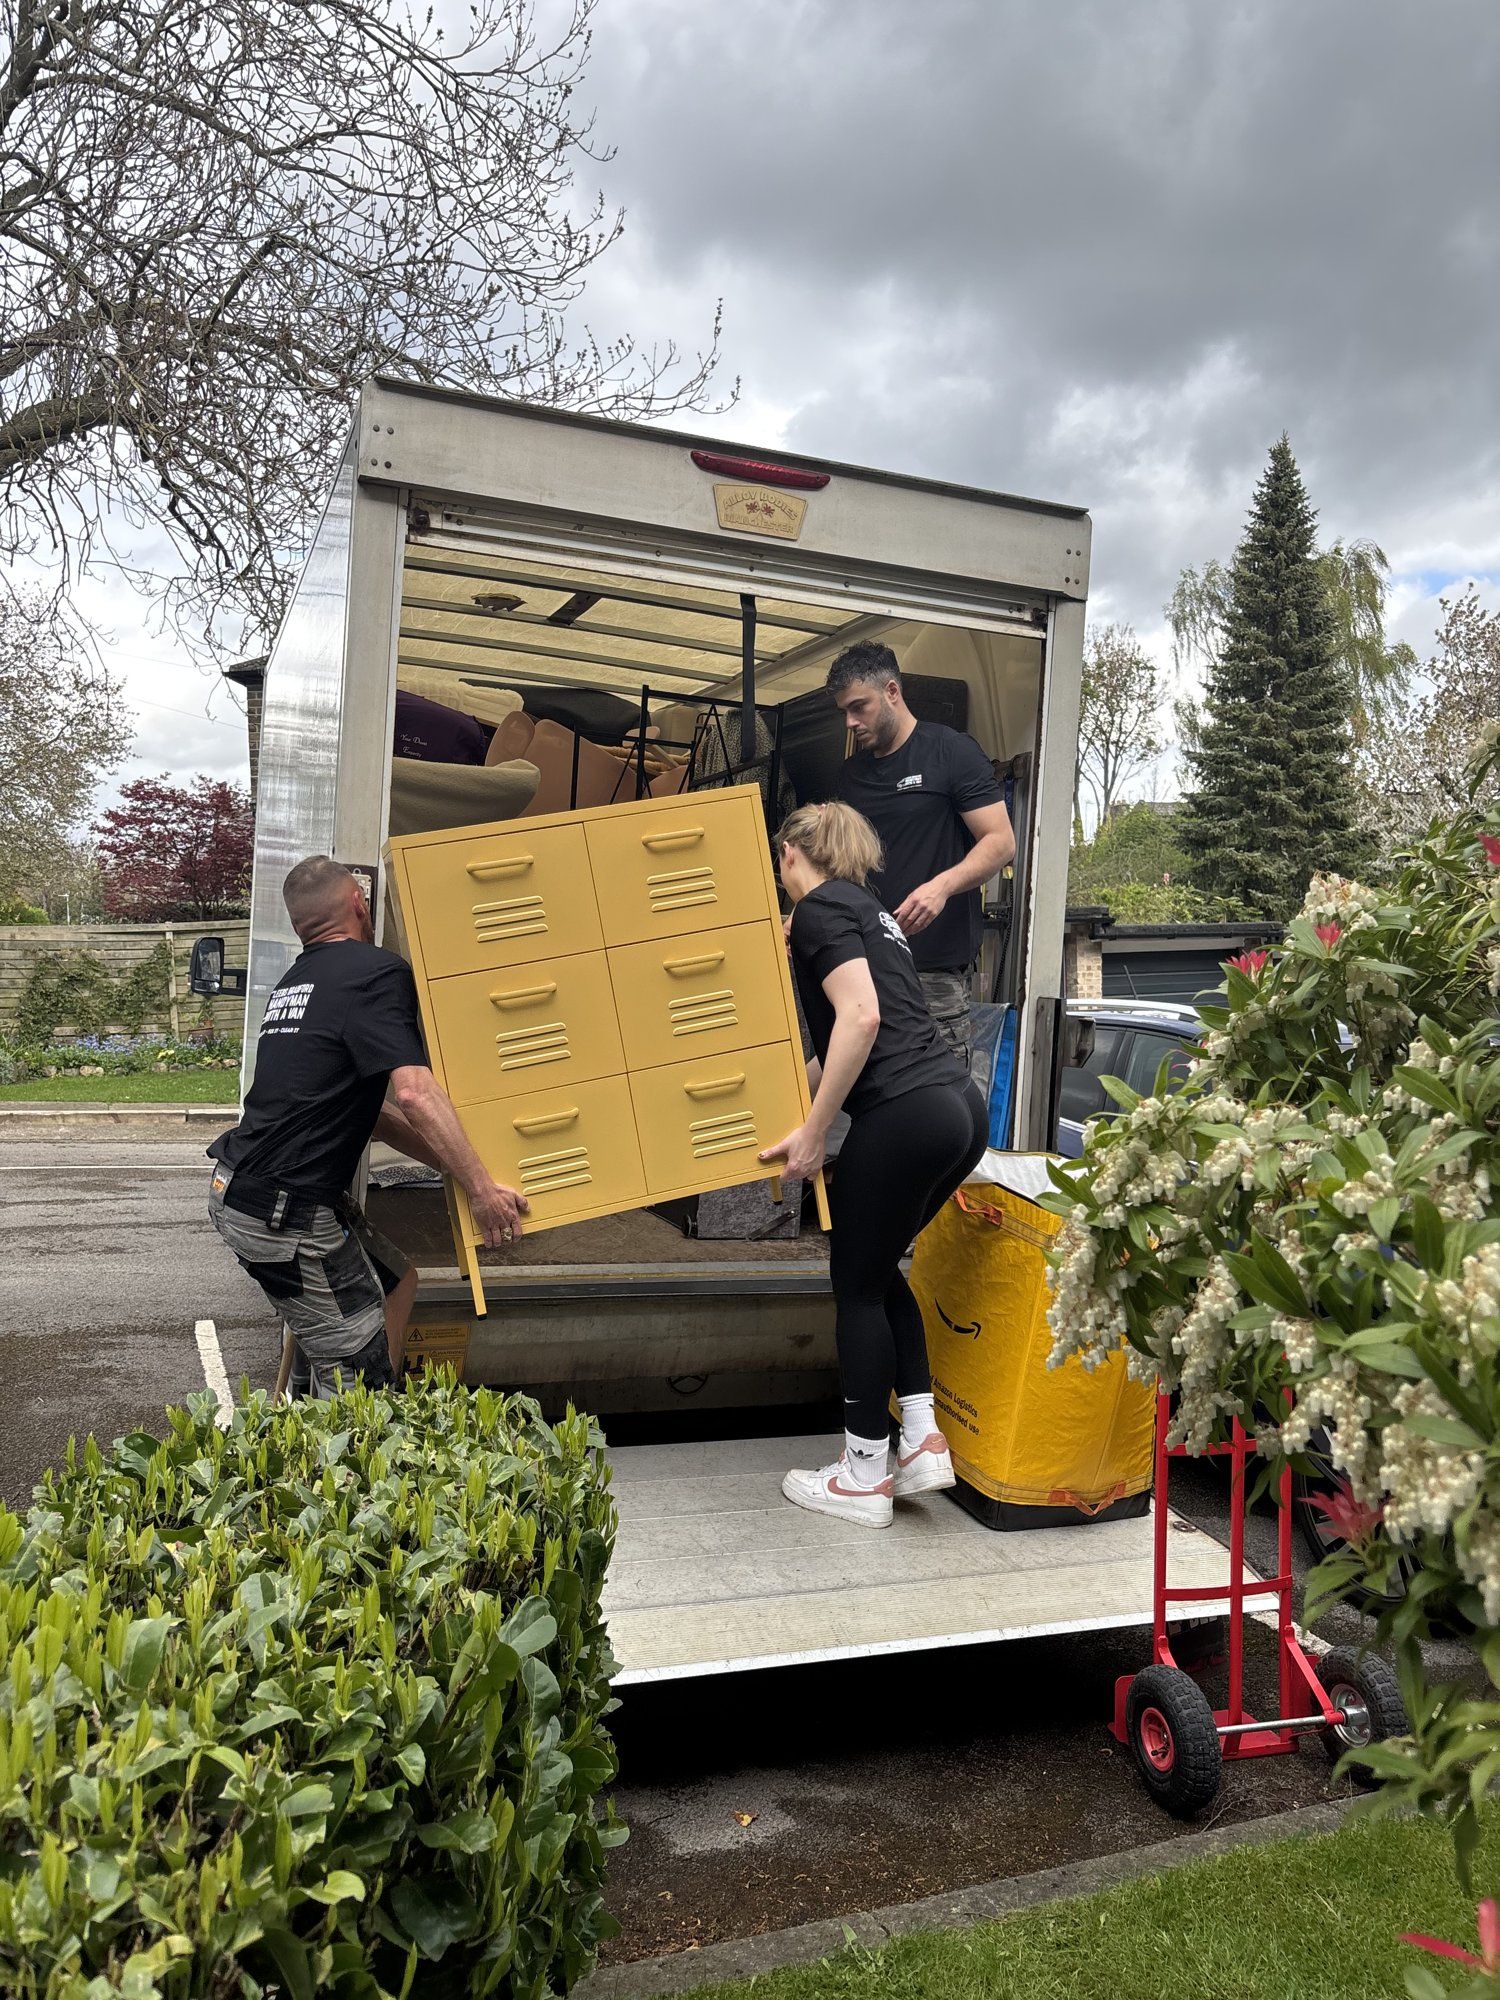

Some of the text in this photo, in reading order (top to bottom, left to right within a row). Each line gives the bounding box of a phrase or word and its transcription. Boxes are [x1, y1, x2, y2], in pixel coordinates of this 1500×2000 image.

[723, 490, 799, 521] ALLOY BODIES
[280, 1008, 287, 1020] A
[288, 1007, 306, 1020] VAN
[933, 1379, 953, 1399] Amazon
[954, 1393, 978, 1417] Logistics
[969, 1424, 979, 1435] use
